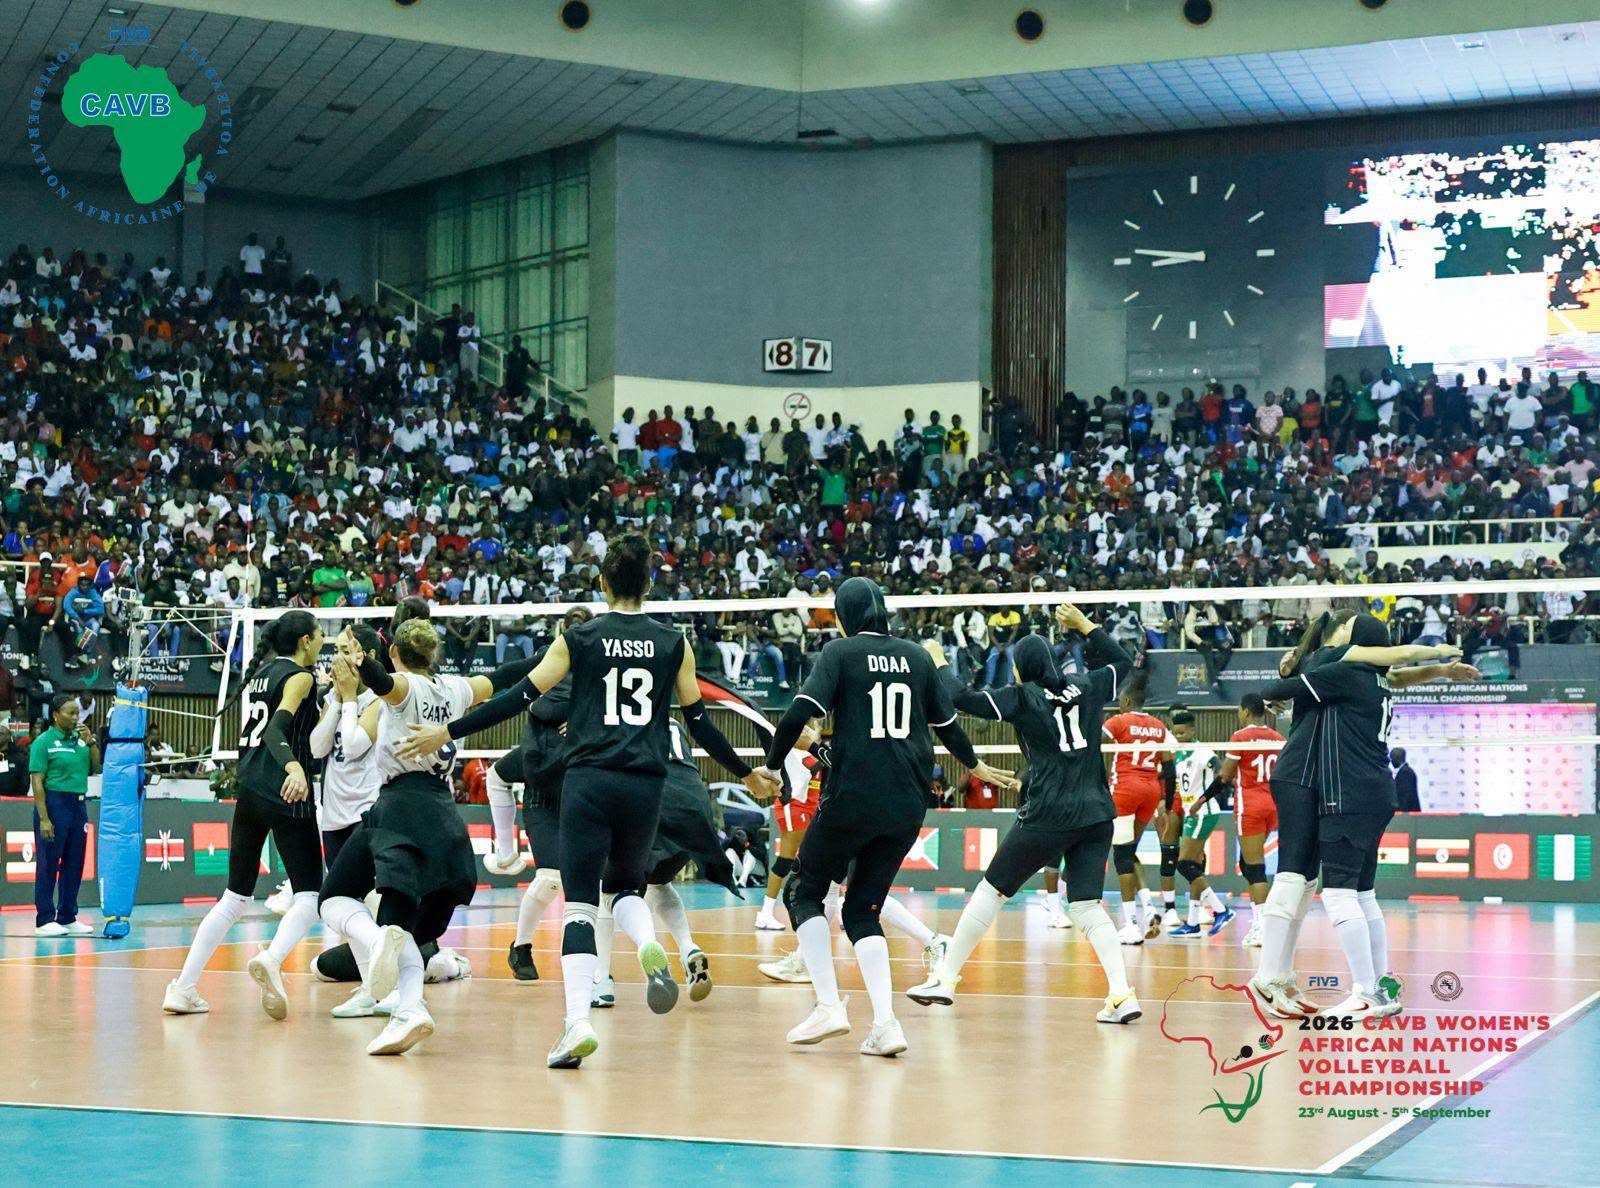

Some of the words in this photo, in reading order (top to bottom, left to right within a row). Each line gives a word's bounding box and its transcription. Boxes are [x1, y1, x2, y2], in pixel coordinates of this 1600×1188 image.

[775, 341, 793, 366] 8
[805, 341, 821, 367] 7
[602, 638, 655, 658] YASSO
[867, 654, 911, 674] DOAA
[602, 667, 654, 726] 13
[1390, 695, 1438, 703] OLLEYBALL
[1440, 694, 1507, 703] CHAMPIONSHIP
[1407, 684, 1448, 692] WOMEN'S
[1449, 684, 1487, 692] AFRICAN
[1489, 684, 1528, 692] NATIONS
[867, 681, 912, 739] 10
[1052, 704, 1088, 752] 11
[1129, 725, 1163, 738] EKARU
[1131, 739, 1156, 768] 12
[1181, 772, 1190, 792] 6
